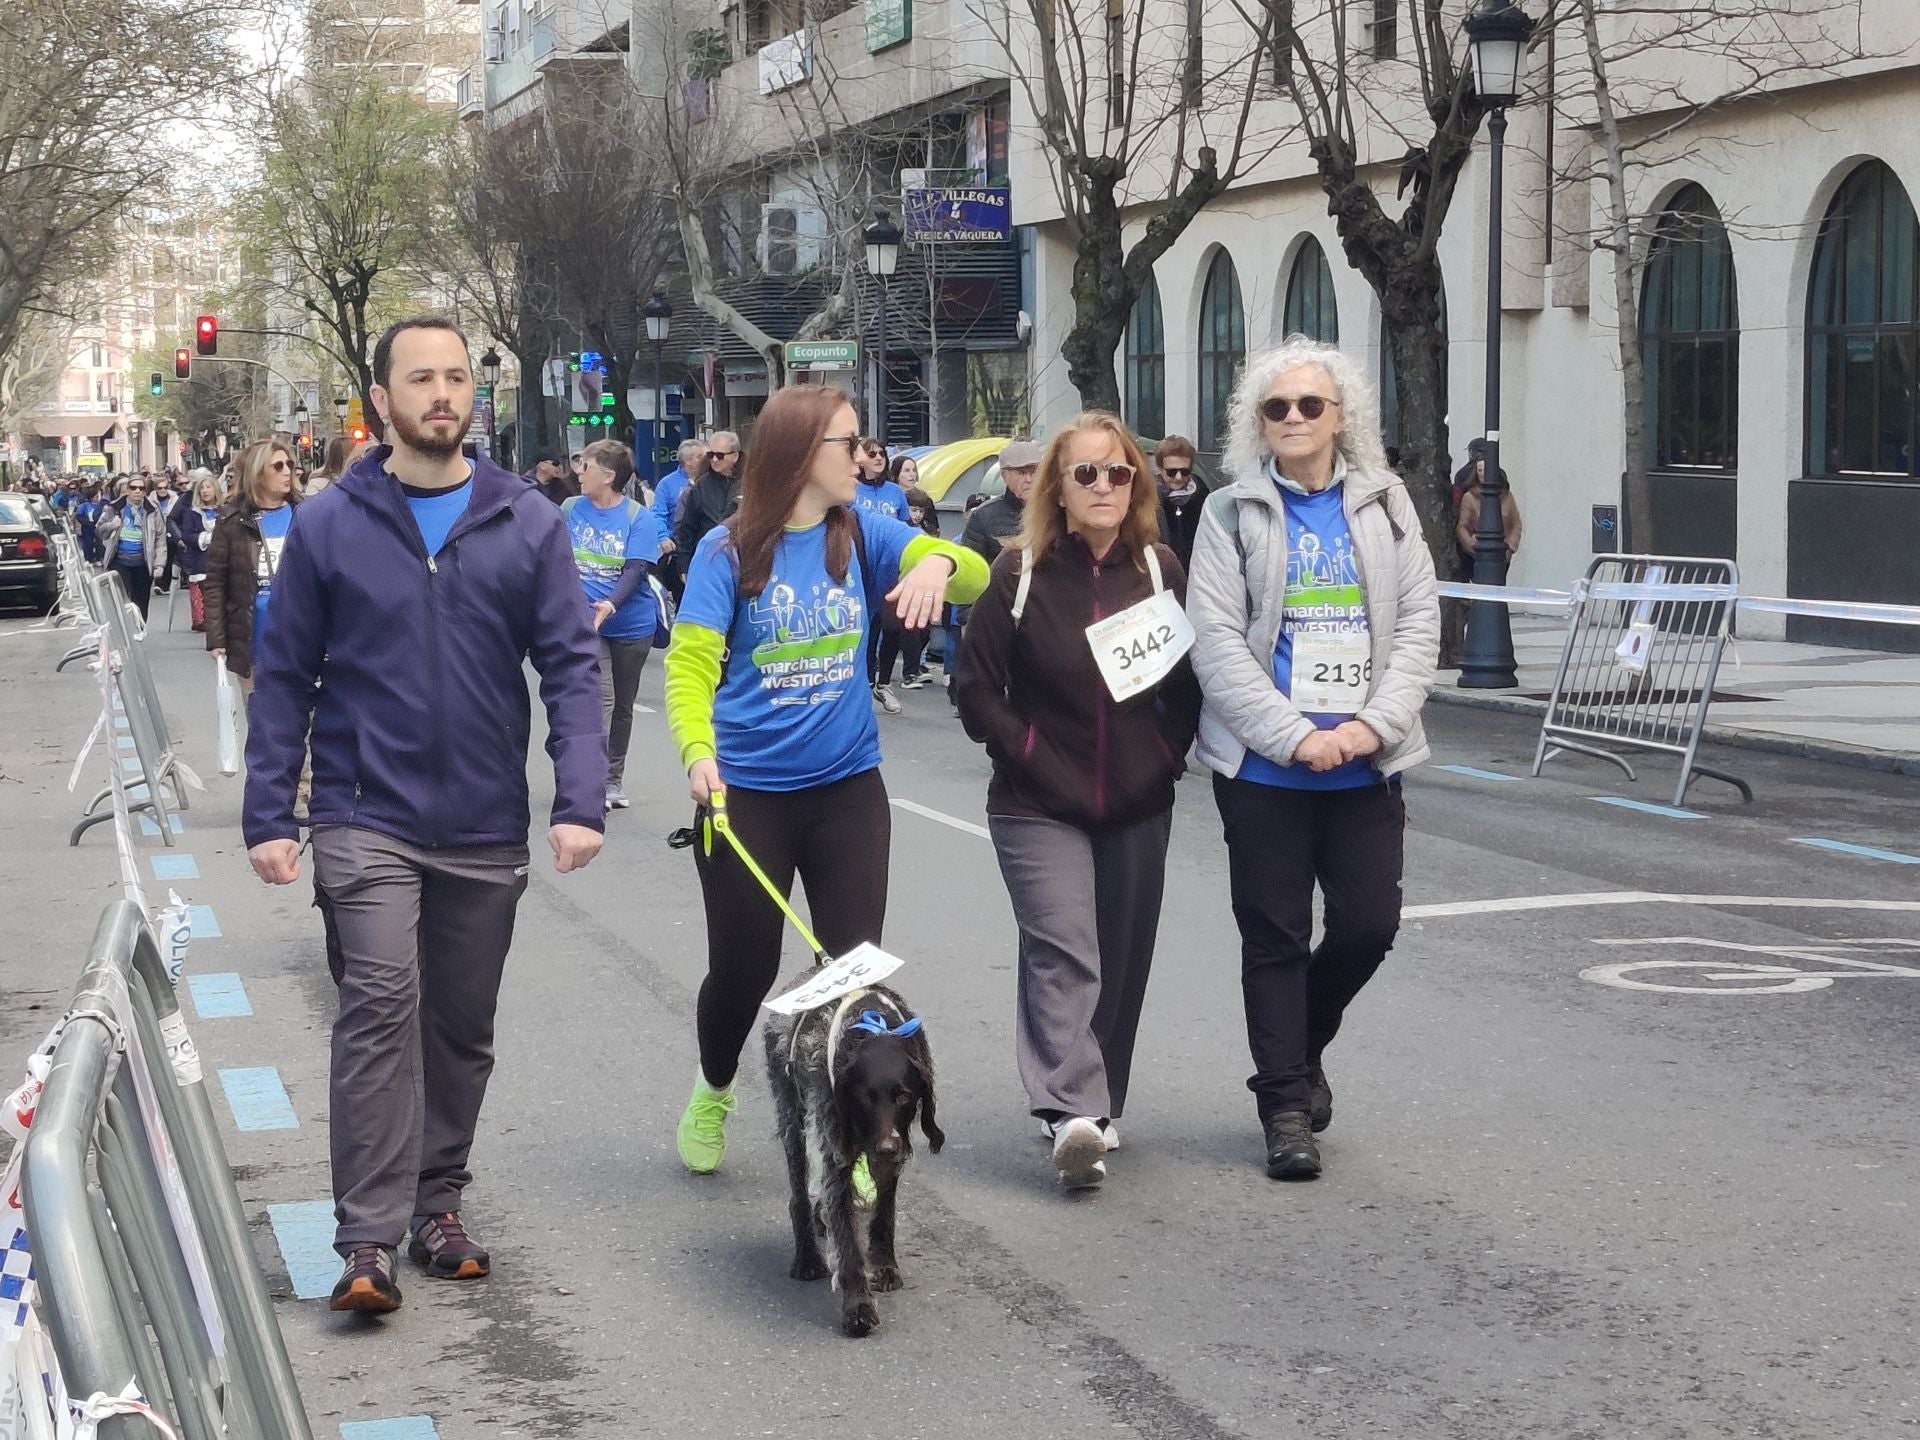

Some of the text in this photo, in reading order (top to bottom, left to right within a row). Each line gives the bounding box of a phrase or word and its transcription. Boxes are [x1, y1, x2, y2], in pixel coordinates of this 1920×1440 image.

[942, 189, 1005, 207] VILLEGAS
[954, 230, 1003, 240] VAQUERA
[794, 346, 848, 359] Ecopunto
[1283, 602, 1345, 618] marcha
[1285, 620, 1369, 634] INVESTIGAC
[1111, 624, 1177, 671] 3442
[760, 655, 820, 675] marcha
